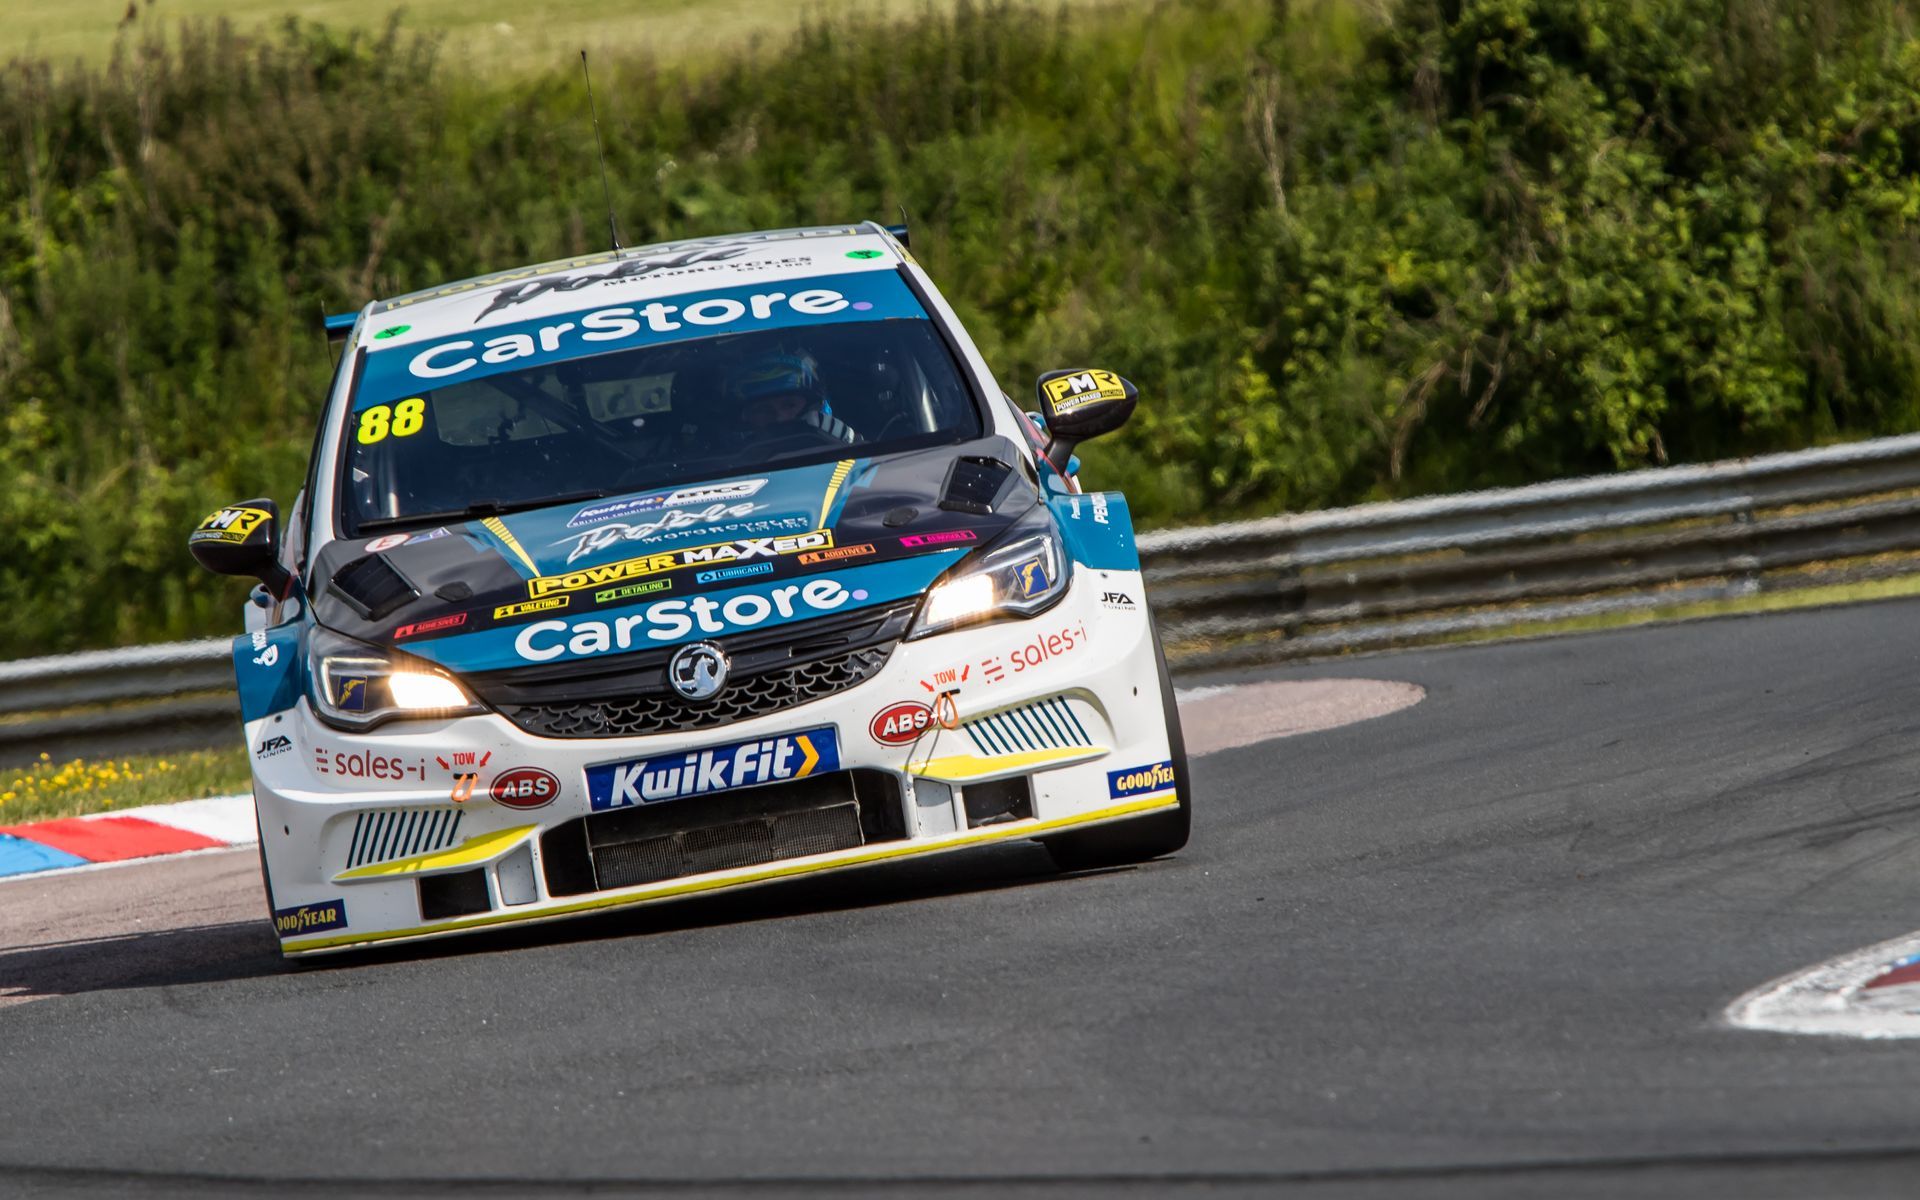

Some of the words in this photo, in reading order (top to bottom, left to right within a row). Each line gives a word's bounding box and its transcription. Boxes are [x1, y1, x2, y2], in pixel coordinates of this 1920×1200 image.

[603, 256, 813, 288] MOTORCYCLES
[1047, 372, 1118, 402] PMR
[1056, 399, 1080, 412] POWER
[357, 397, 425, 445] 88
[641, 516, 808, 544] MOTORCYCLES
[824, 545, 868, 559] ADDITIVES
[536, 556, 681, 594] POWER
[683, 532, 826, 564] MAXED
[717, 563, 770, 579] LUBRICANTS
[620, 581, 664, 596] DETAILING
[1100, 592, 1135, 605] JFA
[519, 598, 560, 612] VALETING
[1010, 620, 1087, 672] sales-i
[933, 669, 957, 686] TOW
[882, 710, 928, 737] ABS
[256, 735, 292, 755] JFA
[257, 746, 292, 761] TUNING
[335, 749, 426, 782] sales-i
[452, 752, 476, 766] TOW
[1117, 764, 1175, 791] GOODYEA
[501, 778, 551, 799] ABS
[277, 907, 337, 932] OODYEAR
